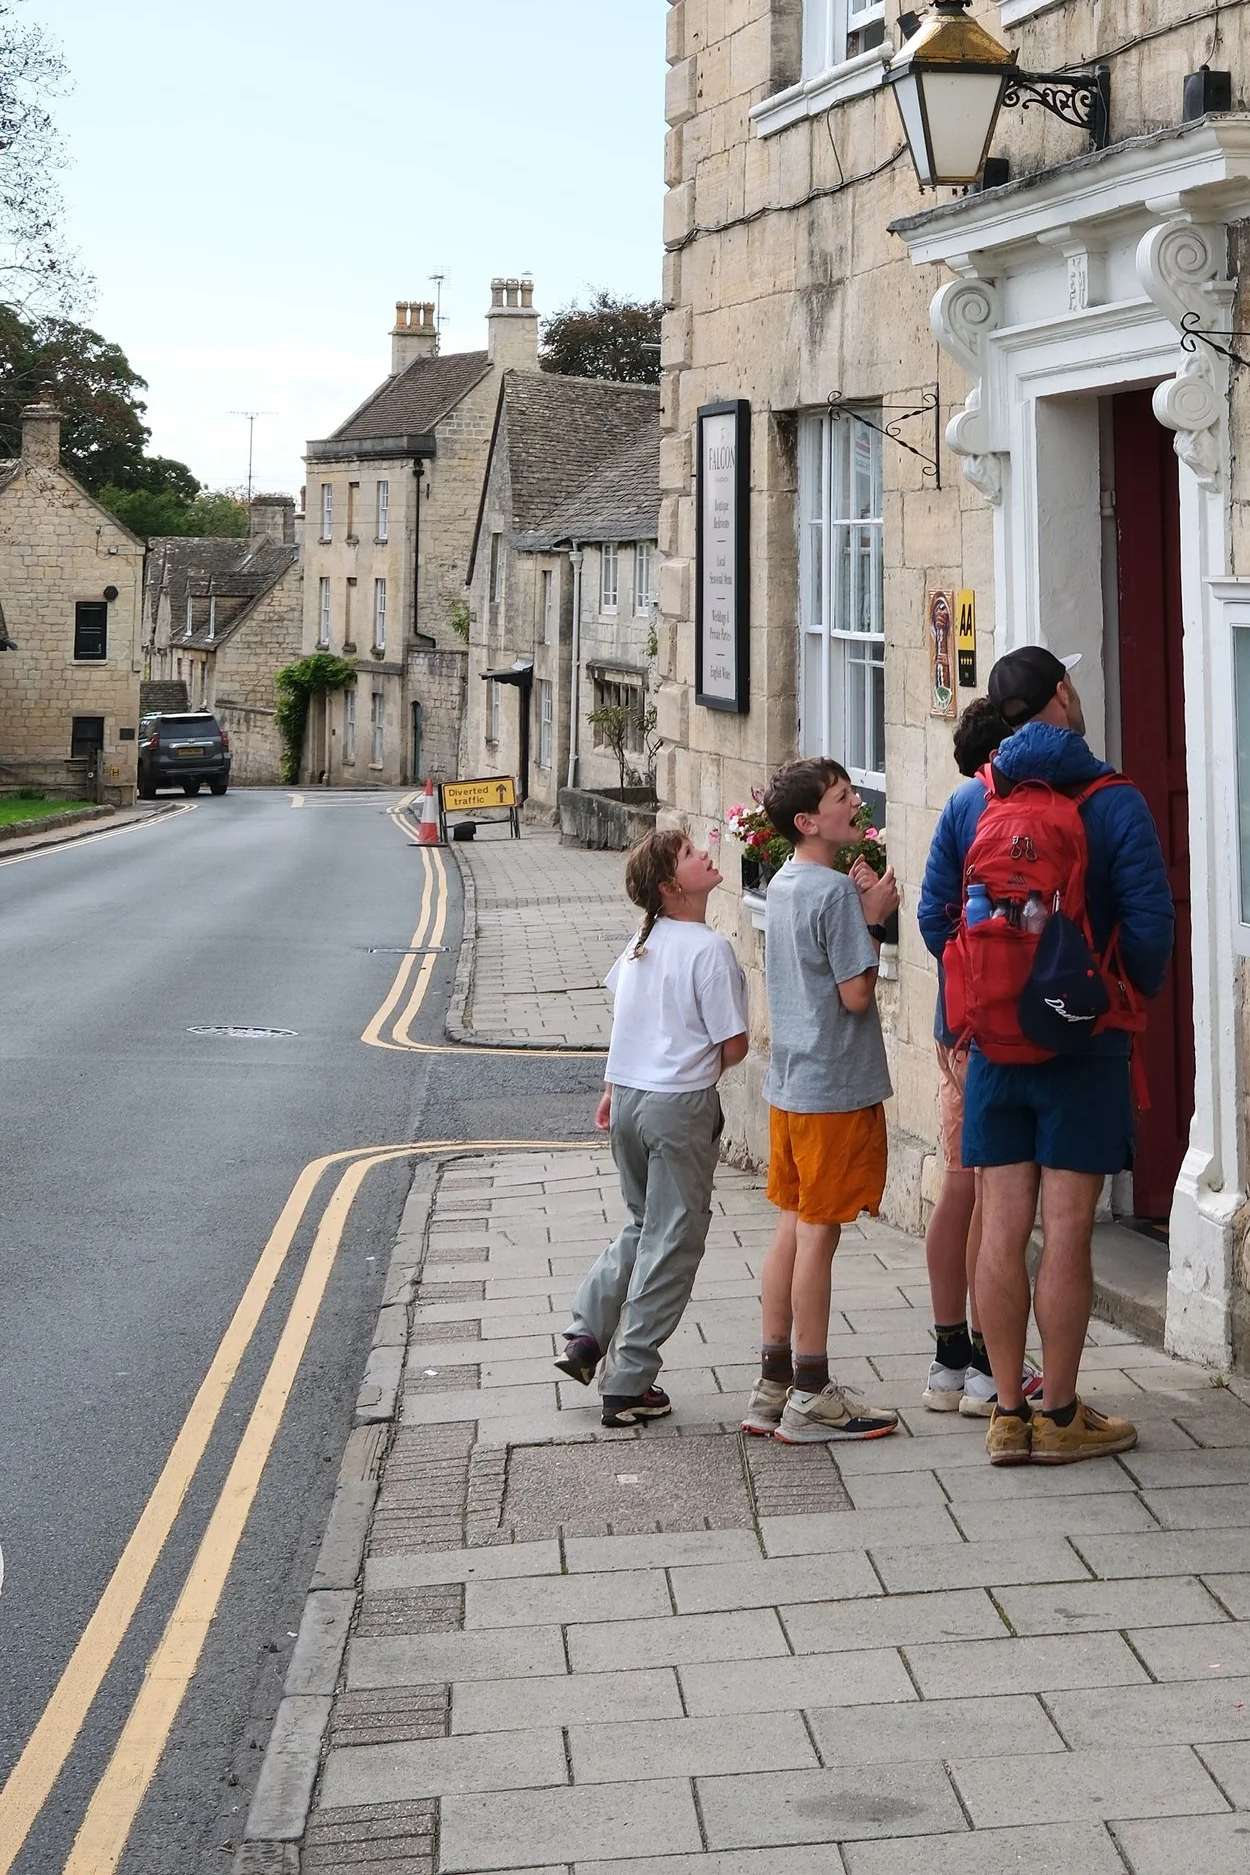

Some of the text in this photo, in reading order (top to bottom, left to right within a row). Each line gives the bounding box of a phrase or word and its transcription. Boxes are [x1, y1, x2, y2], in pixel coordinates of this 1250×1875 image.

[959, 603, 972, 637] AA
[448, 786, 489, 797] Diverted
[454, 796, 485, 806] traffic
